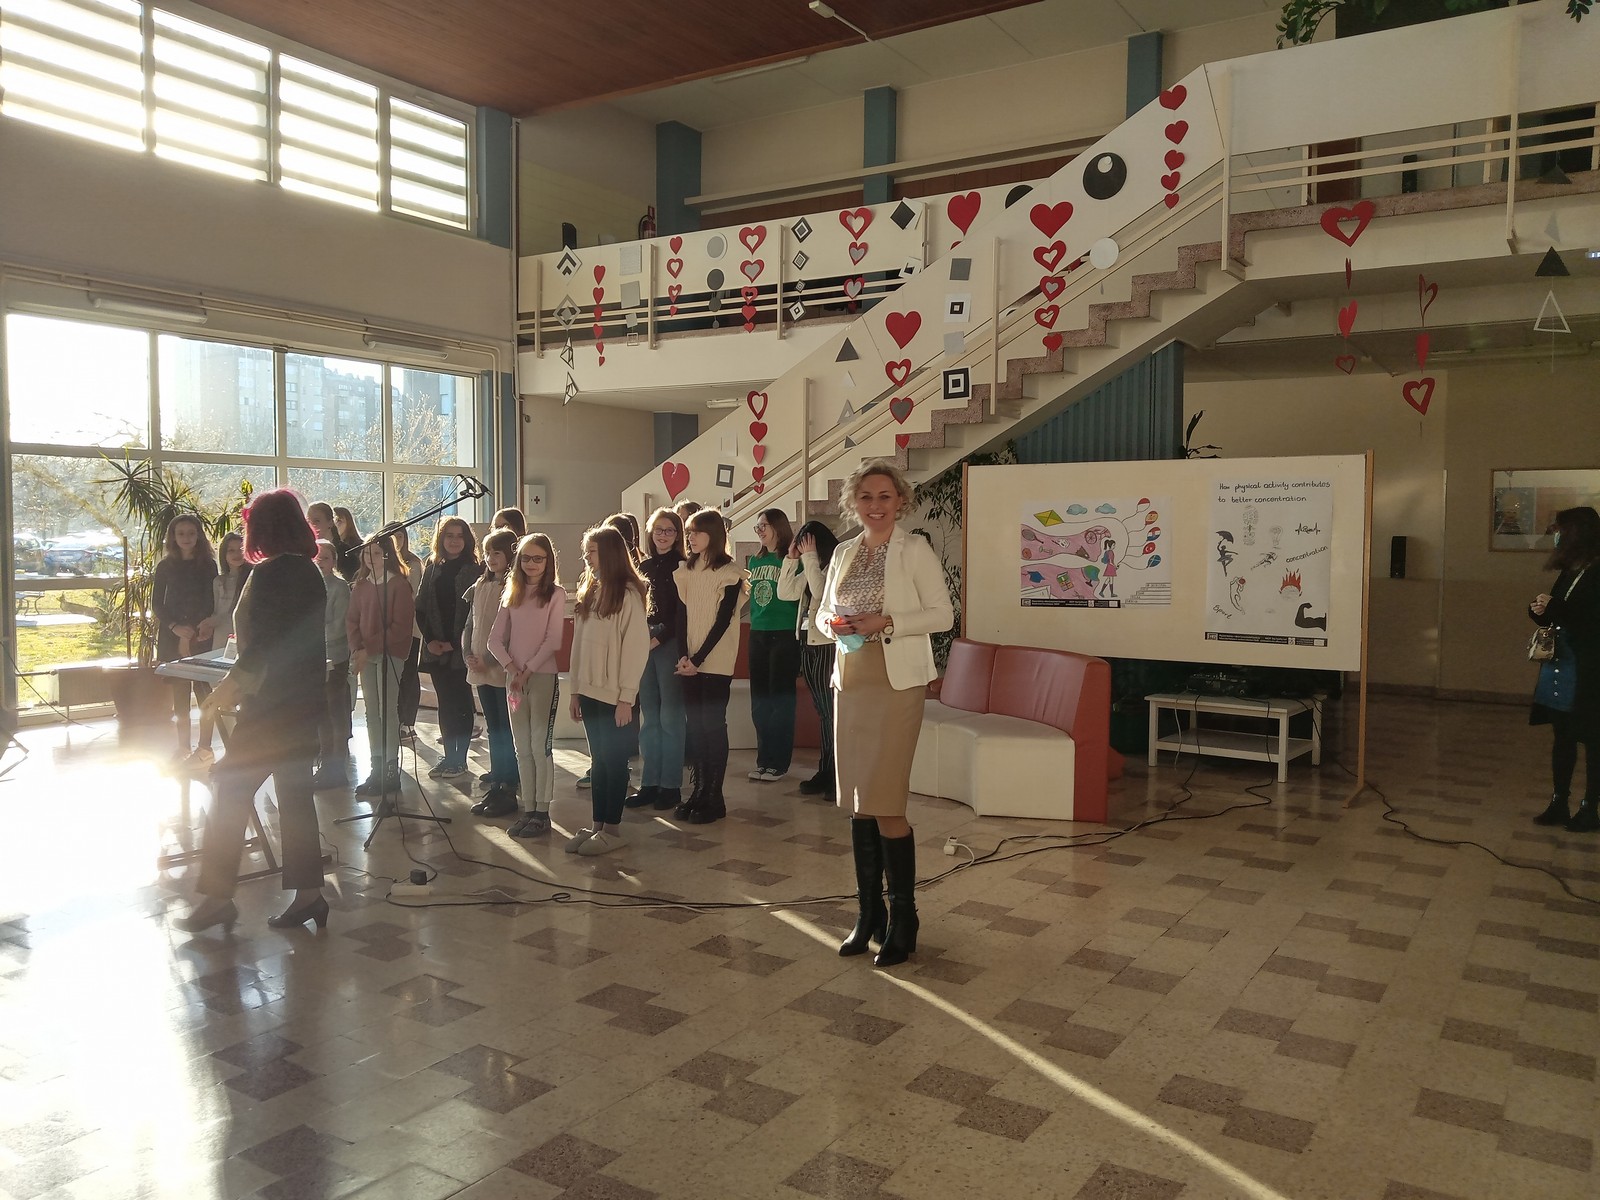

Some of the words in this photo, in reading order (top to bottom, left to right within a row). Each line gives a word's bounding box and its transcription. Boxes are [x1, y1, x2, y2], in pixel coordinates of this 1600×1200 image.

[1234, 482, 1261, 493] physical
[1263, 481, 1289, 490] activity
[1285, 545, 1329, 563] concentration
